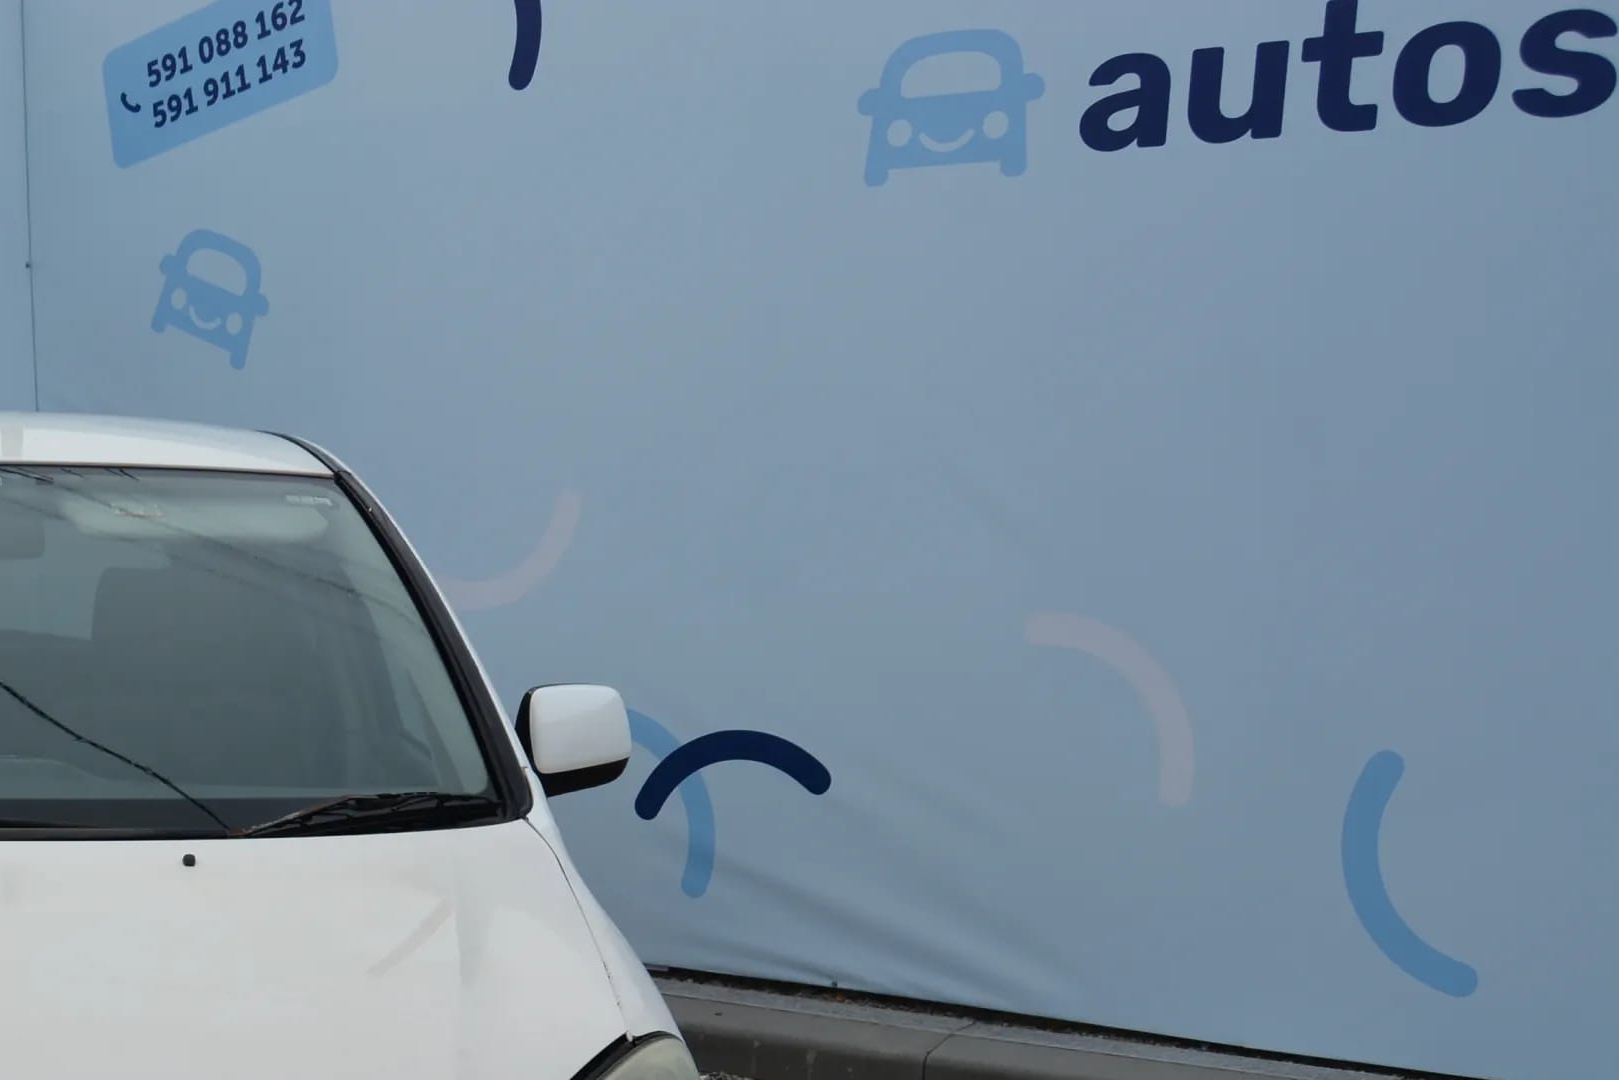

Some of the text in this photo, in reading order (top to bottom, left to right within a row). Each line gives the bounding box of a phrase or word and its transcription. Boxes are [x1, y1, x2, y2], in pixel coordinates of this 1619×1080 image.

[147, 0, 306, 88] 591 088 162
[152, 38, 306, 129] 591 911 143
[1079, 0, 1618, 152] autos
